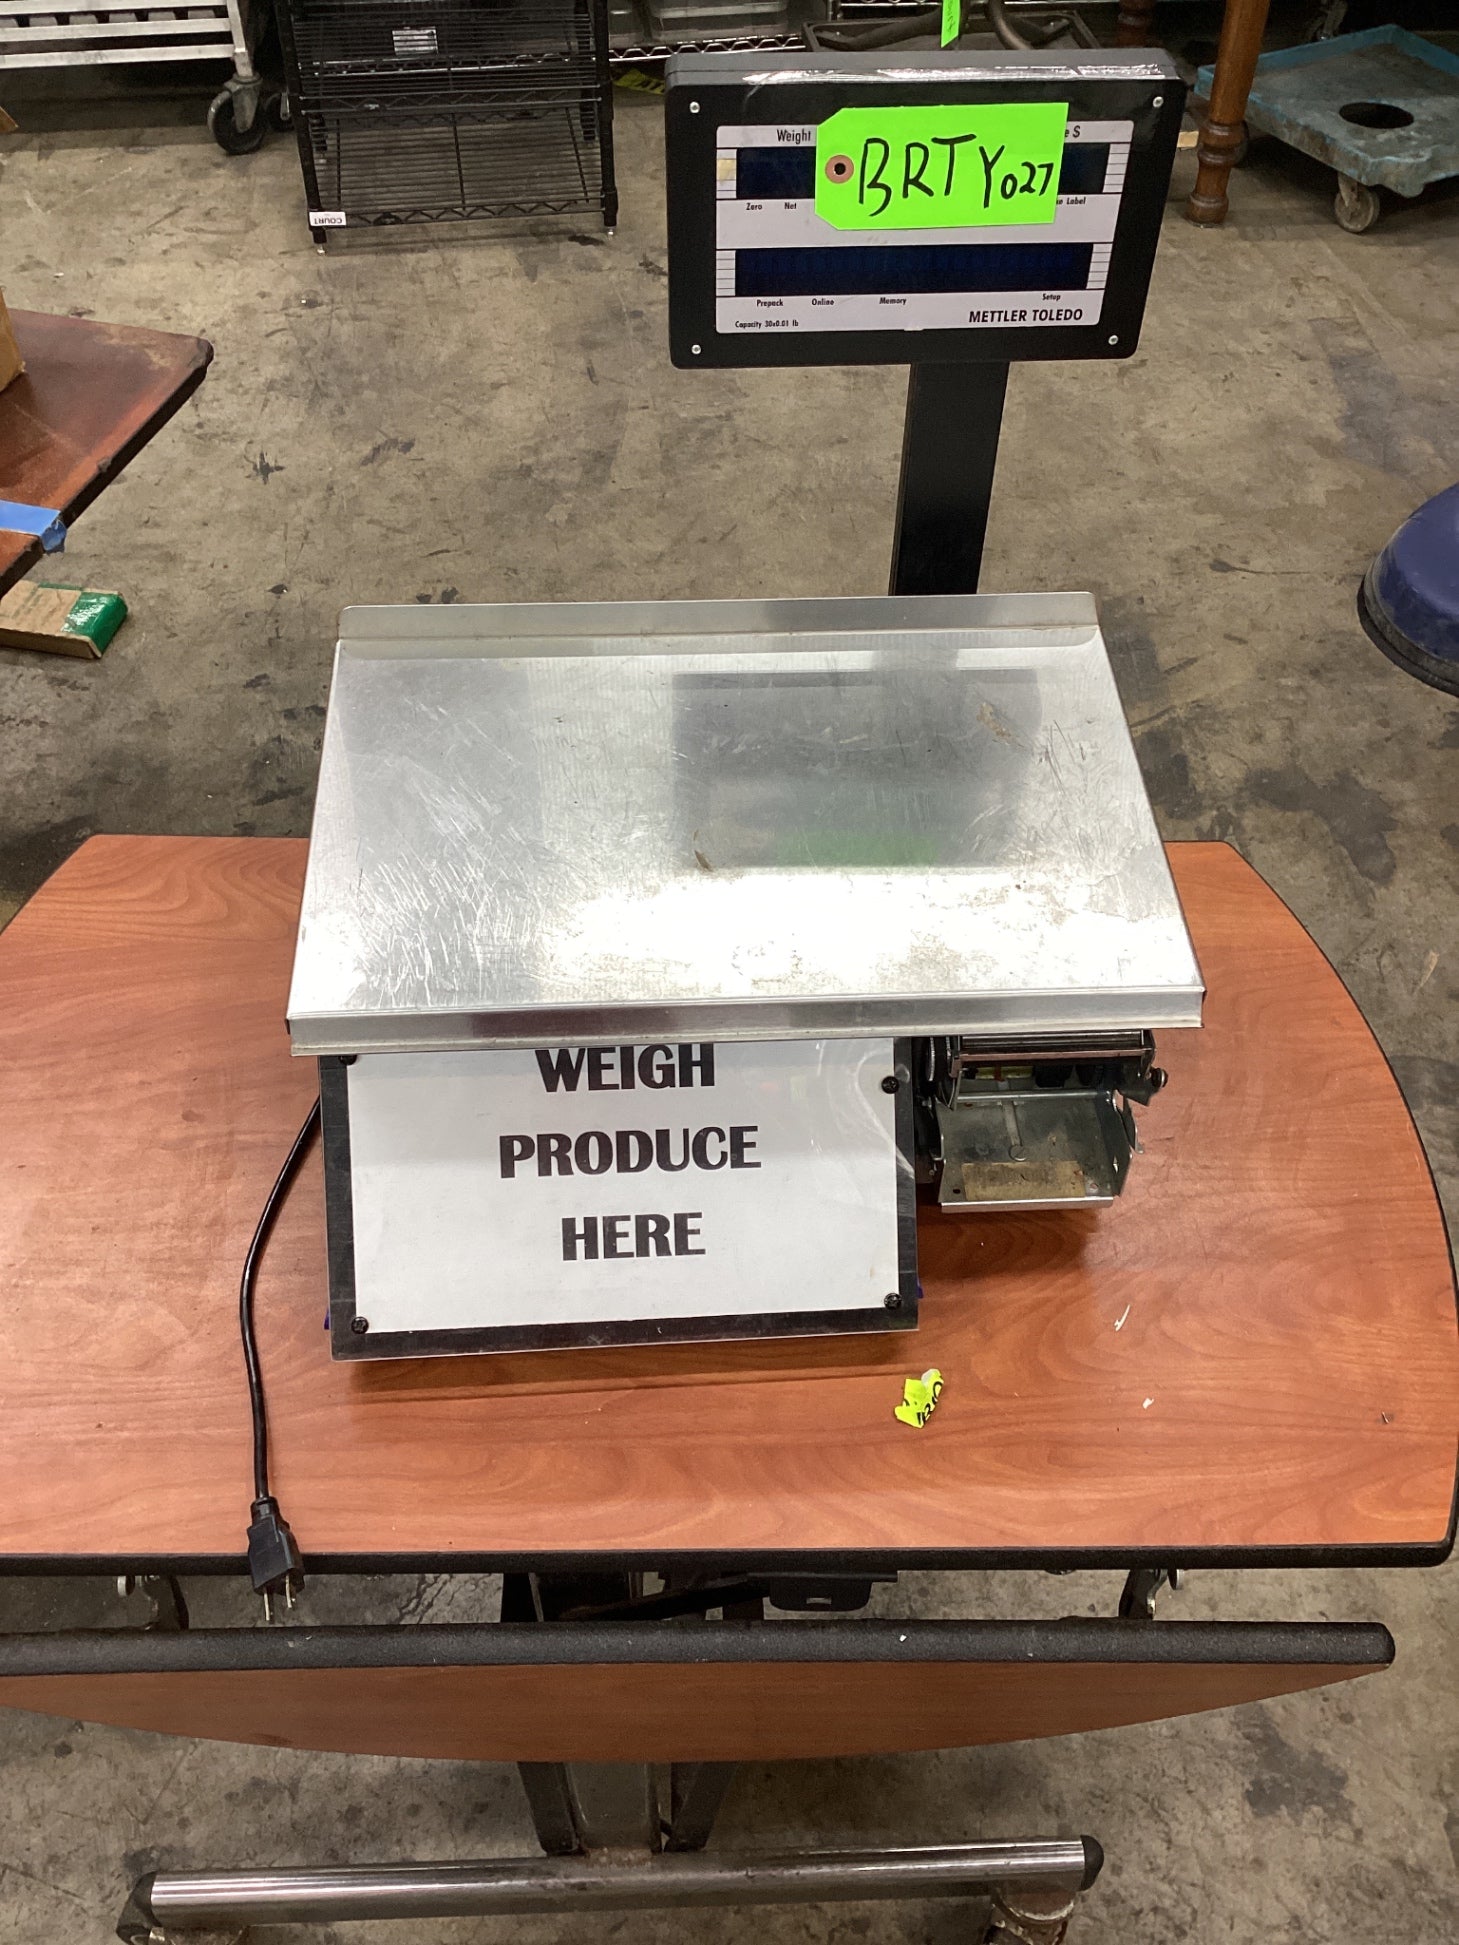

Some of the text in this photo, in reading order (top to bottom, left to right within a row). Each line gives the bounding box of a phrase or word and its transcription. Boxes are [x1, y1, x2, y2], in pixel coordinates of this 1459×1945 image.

[776, 128, 811, 145] Weight
[784, 202, 797, 210] Net
[1066, 197, 1087, 205] Label
[745, 202, 763, 211] Zero
[811, 298, 835, 306] Online
[879, 297, 907, 306] Memory
[1042, 293, 1061, 301] Setup
[756, 298, 784, 308] Prepack
[968, 308, 1083, 323] METTLER TOLEDO
[735, 320, 762, 330] Capacity
[792, 319, 799, 328] lb
[534, 1043, 716, 1093] WEIGH
[499, 1125, 762, 1179] PRODUCE
[561, 1211, 706, 1262] HERE
